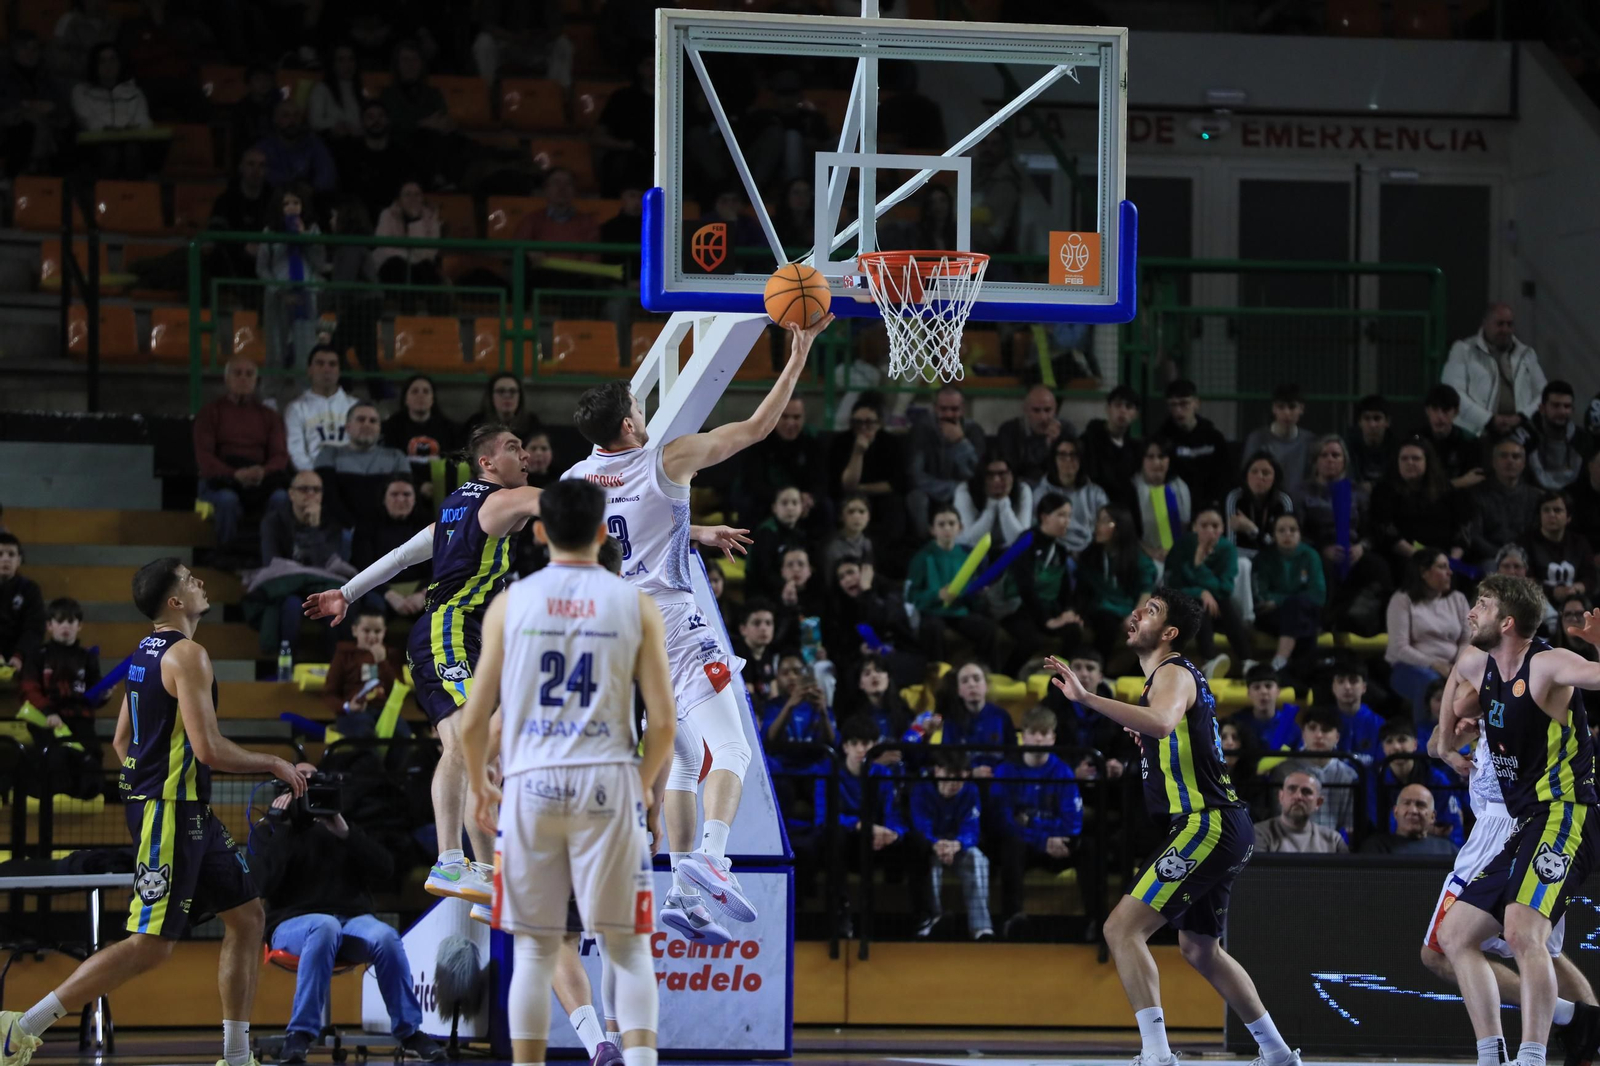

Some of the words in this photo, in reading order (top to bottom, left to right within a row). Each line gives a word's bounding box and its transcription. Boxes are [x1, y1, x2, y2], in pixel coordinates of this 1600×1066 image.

[1129, 115, 1174, 144] DE
[1240, 121, 1488, 151] EMERXENCIA
[1064, 277, 1084, 285] FEB
[547, 598, 597, 619] VARELA
[540, 651, 597, 707] 24
[1488, 699, 1506, 729] 23
[525, 719, 611, 739] ABANCA
